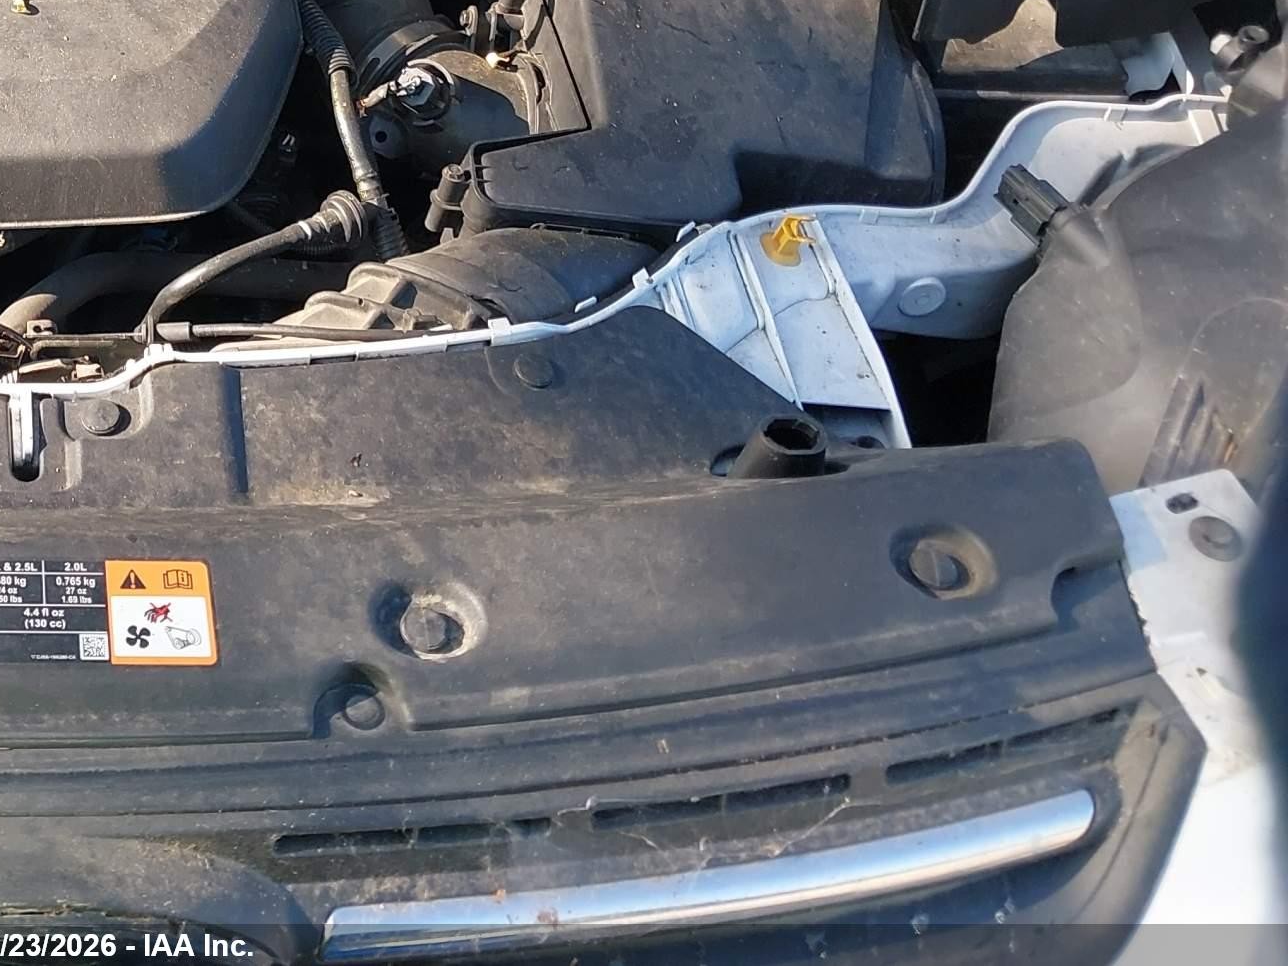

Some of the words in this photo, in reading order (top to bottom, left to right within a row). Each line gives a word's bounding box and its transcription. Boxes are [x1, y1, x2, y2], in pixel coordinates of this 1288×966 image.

[3, 562, 12, 571] &
[14, 562, 38, 571] 2.5L
[64, 562, 87, 572] 2.0L
[14, 576, 27, 587] kg
[55, 576, 82, 586] 0.765
[83, 576, 96, 588] kg
[9, 595, 23, 603] lbs
[79, 595, 92, 603] lbs
[23, 608, 39, 617] 4.4
[41, 607, 49, 617] fl
[51, 609, 65, 617] oz
[24, 619, 47, 629] (130
[49, 619, 66, 629] cc)
